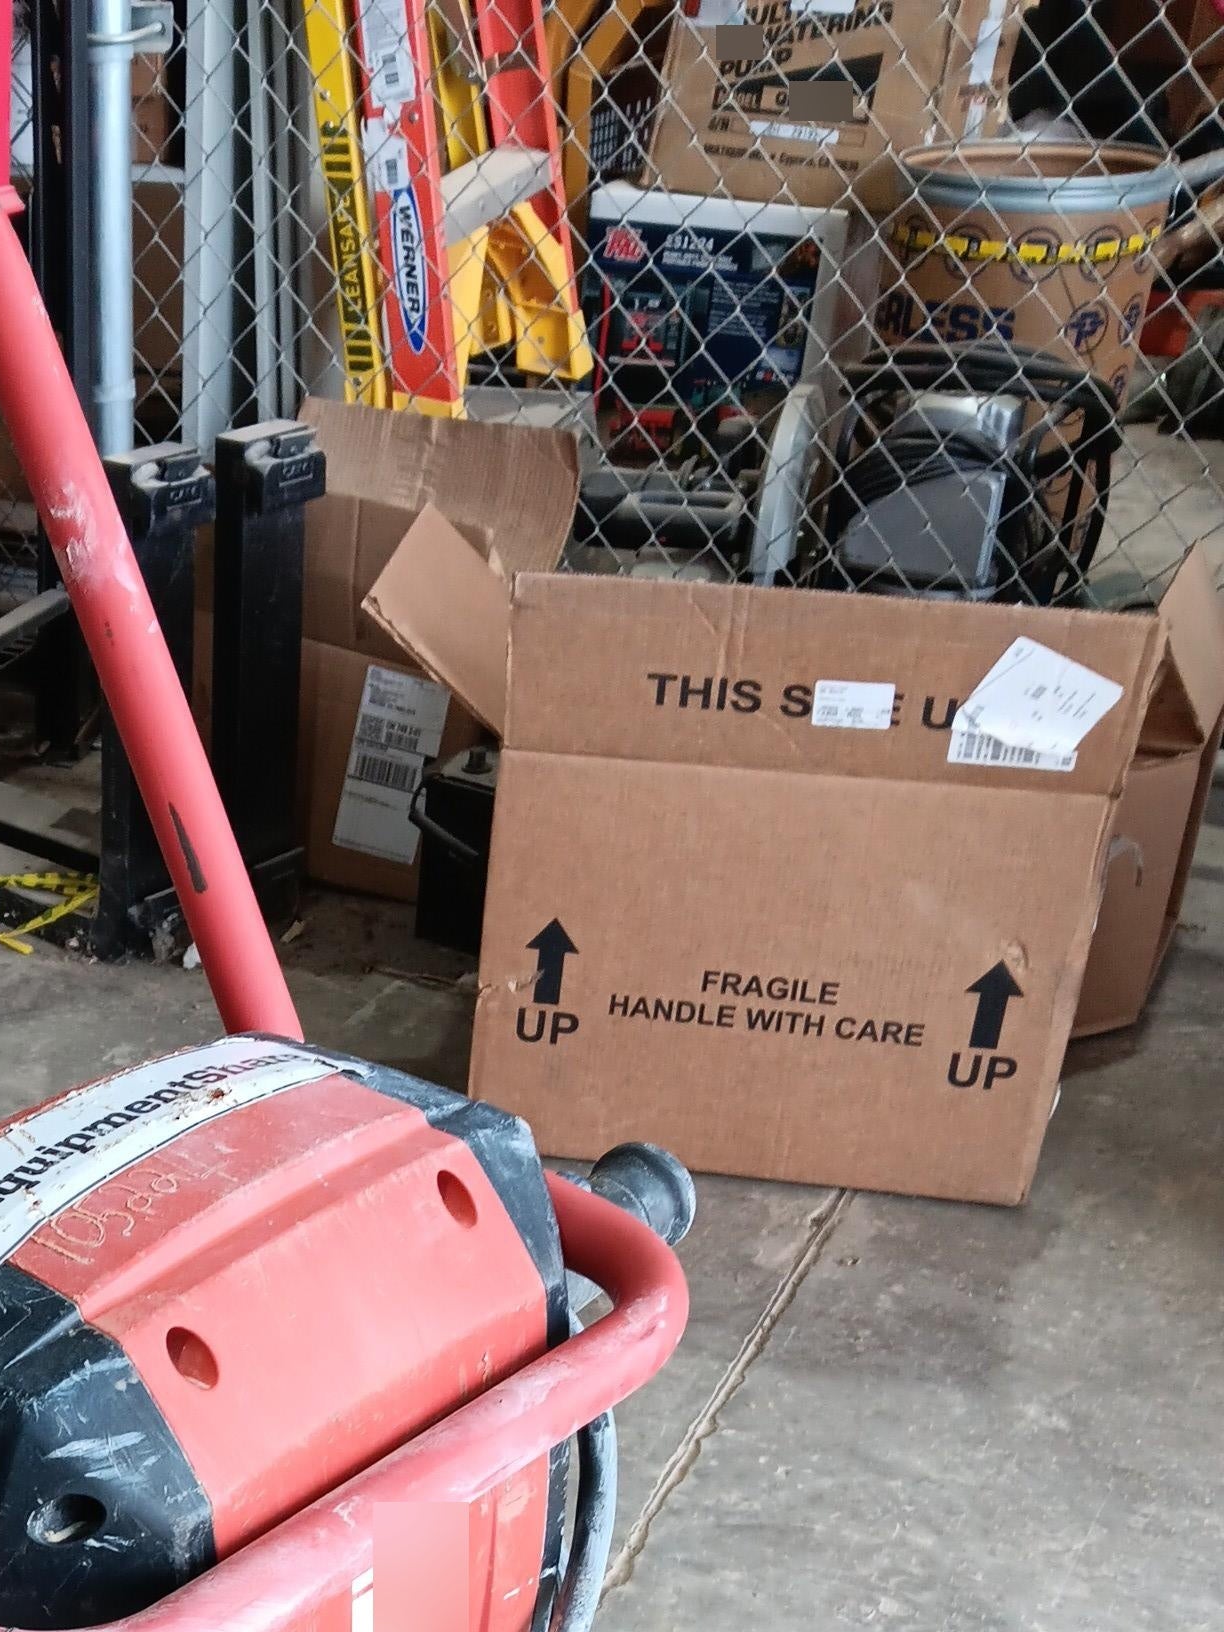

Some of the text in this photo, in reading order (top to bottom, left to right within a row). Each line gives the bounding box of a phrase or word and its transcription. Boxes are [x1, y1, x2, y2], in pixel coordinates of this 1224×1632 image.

[395, 204, 421, 316] WERNER
[646, 672, 762, 714] THIS
[921, 696, 960, 730] U
[699, 969, 841, 1006] FRAGILE
[515, 1007, 580, 1045] UP
[607, 992, 927, 1048] HANDLE WITH CARE
[946, 1051, 1019, 1091] UP
